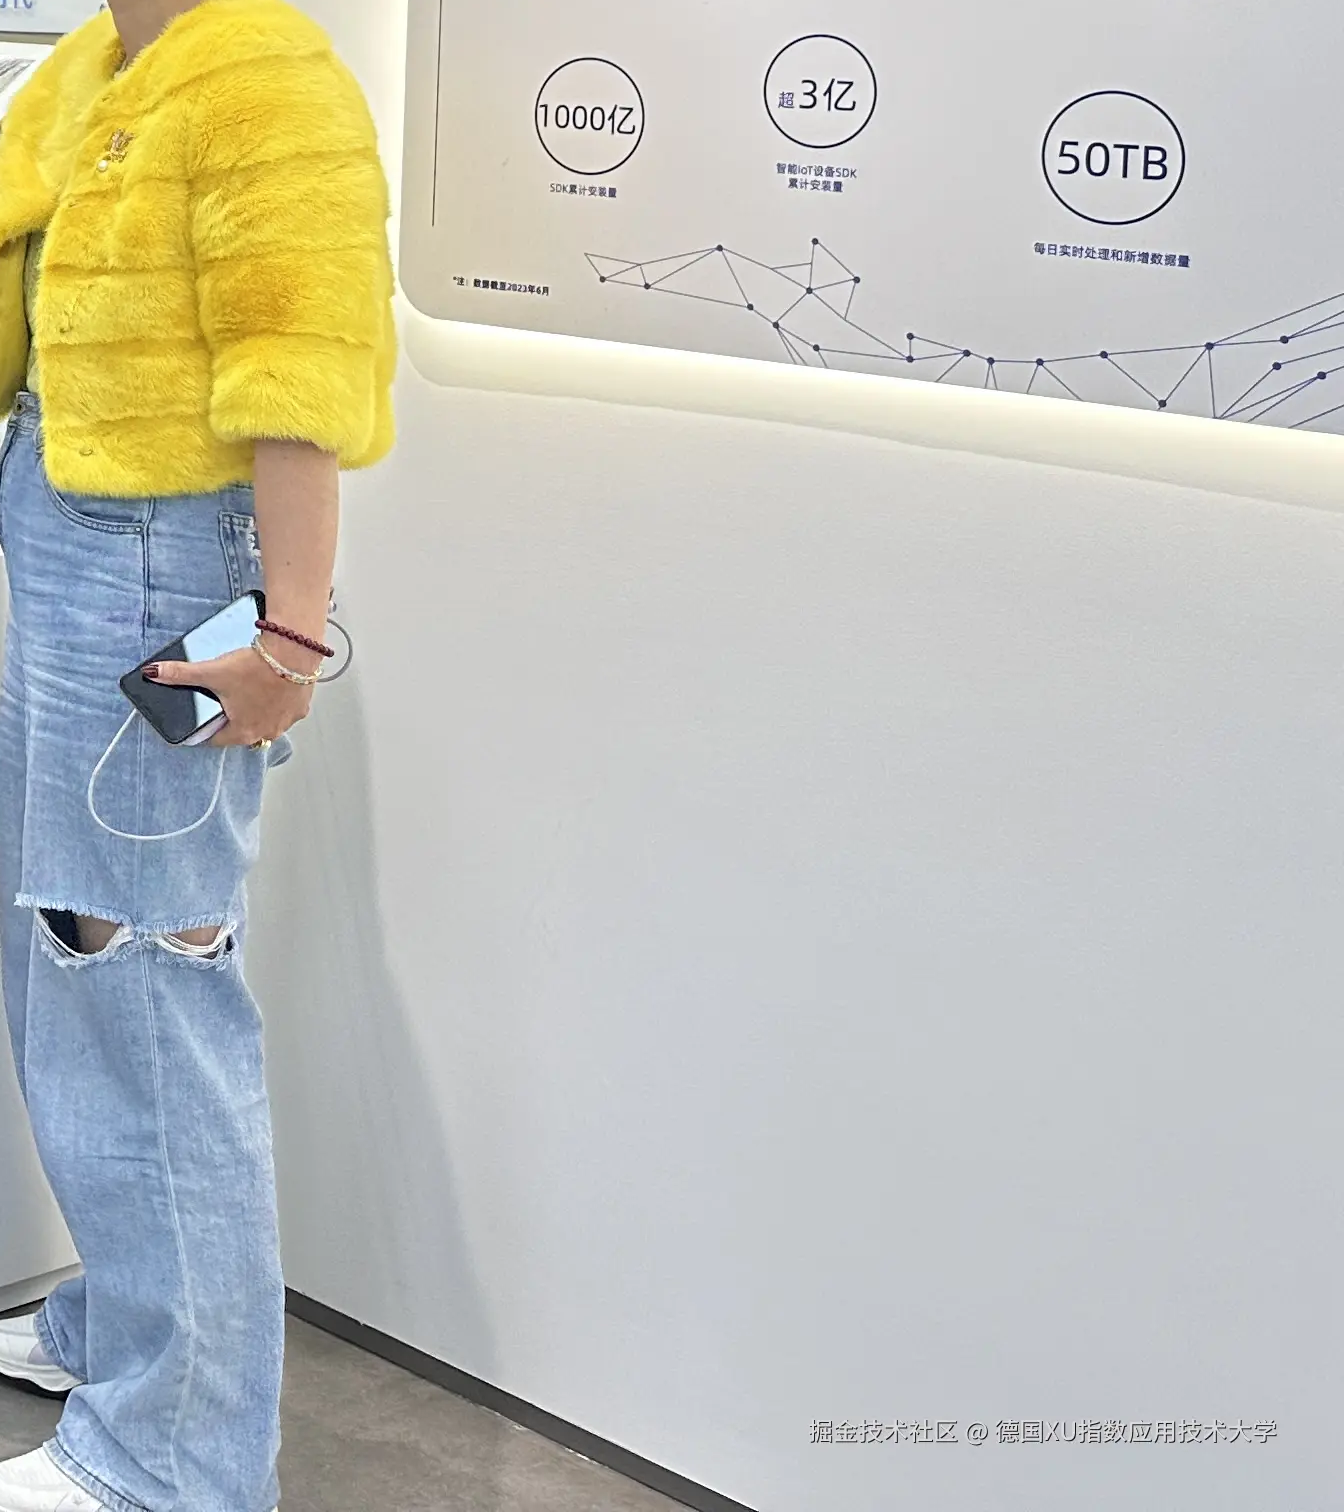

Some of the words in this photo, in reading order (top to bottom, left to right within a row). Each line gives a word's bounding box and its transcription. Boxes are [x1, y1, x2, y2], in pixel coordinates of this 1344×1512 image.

[539, 104, 636, 135] 1000亿
[1057, 140, 1168, 180] 50TB
[549, 182, 617, 198] SDK累计安装量
[788, 177, 844, 192] 累计安装量
[1034, 242, 1191, 268] 每日实时处理和新增数据量
